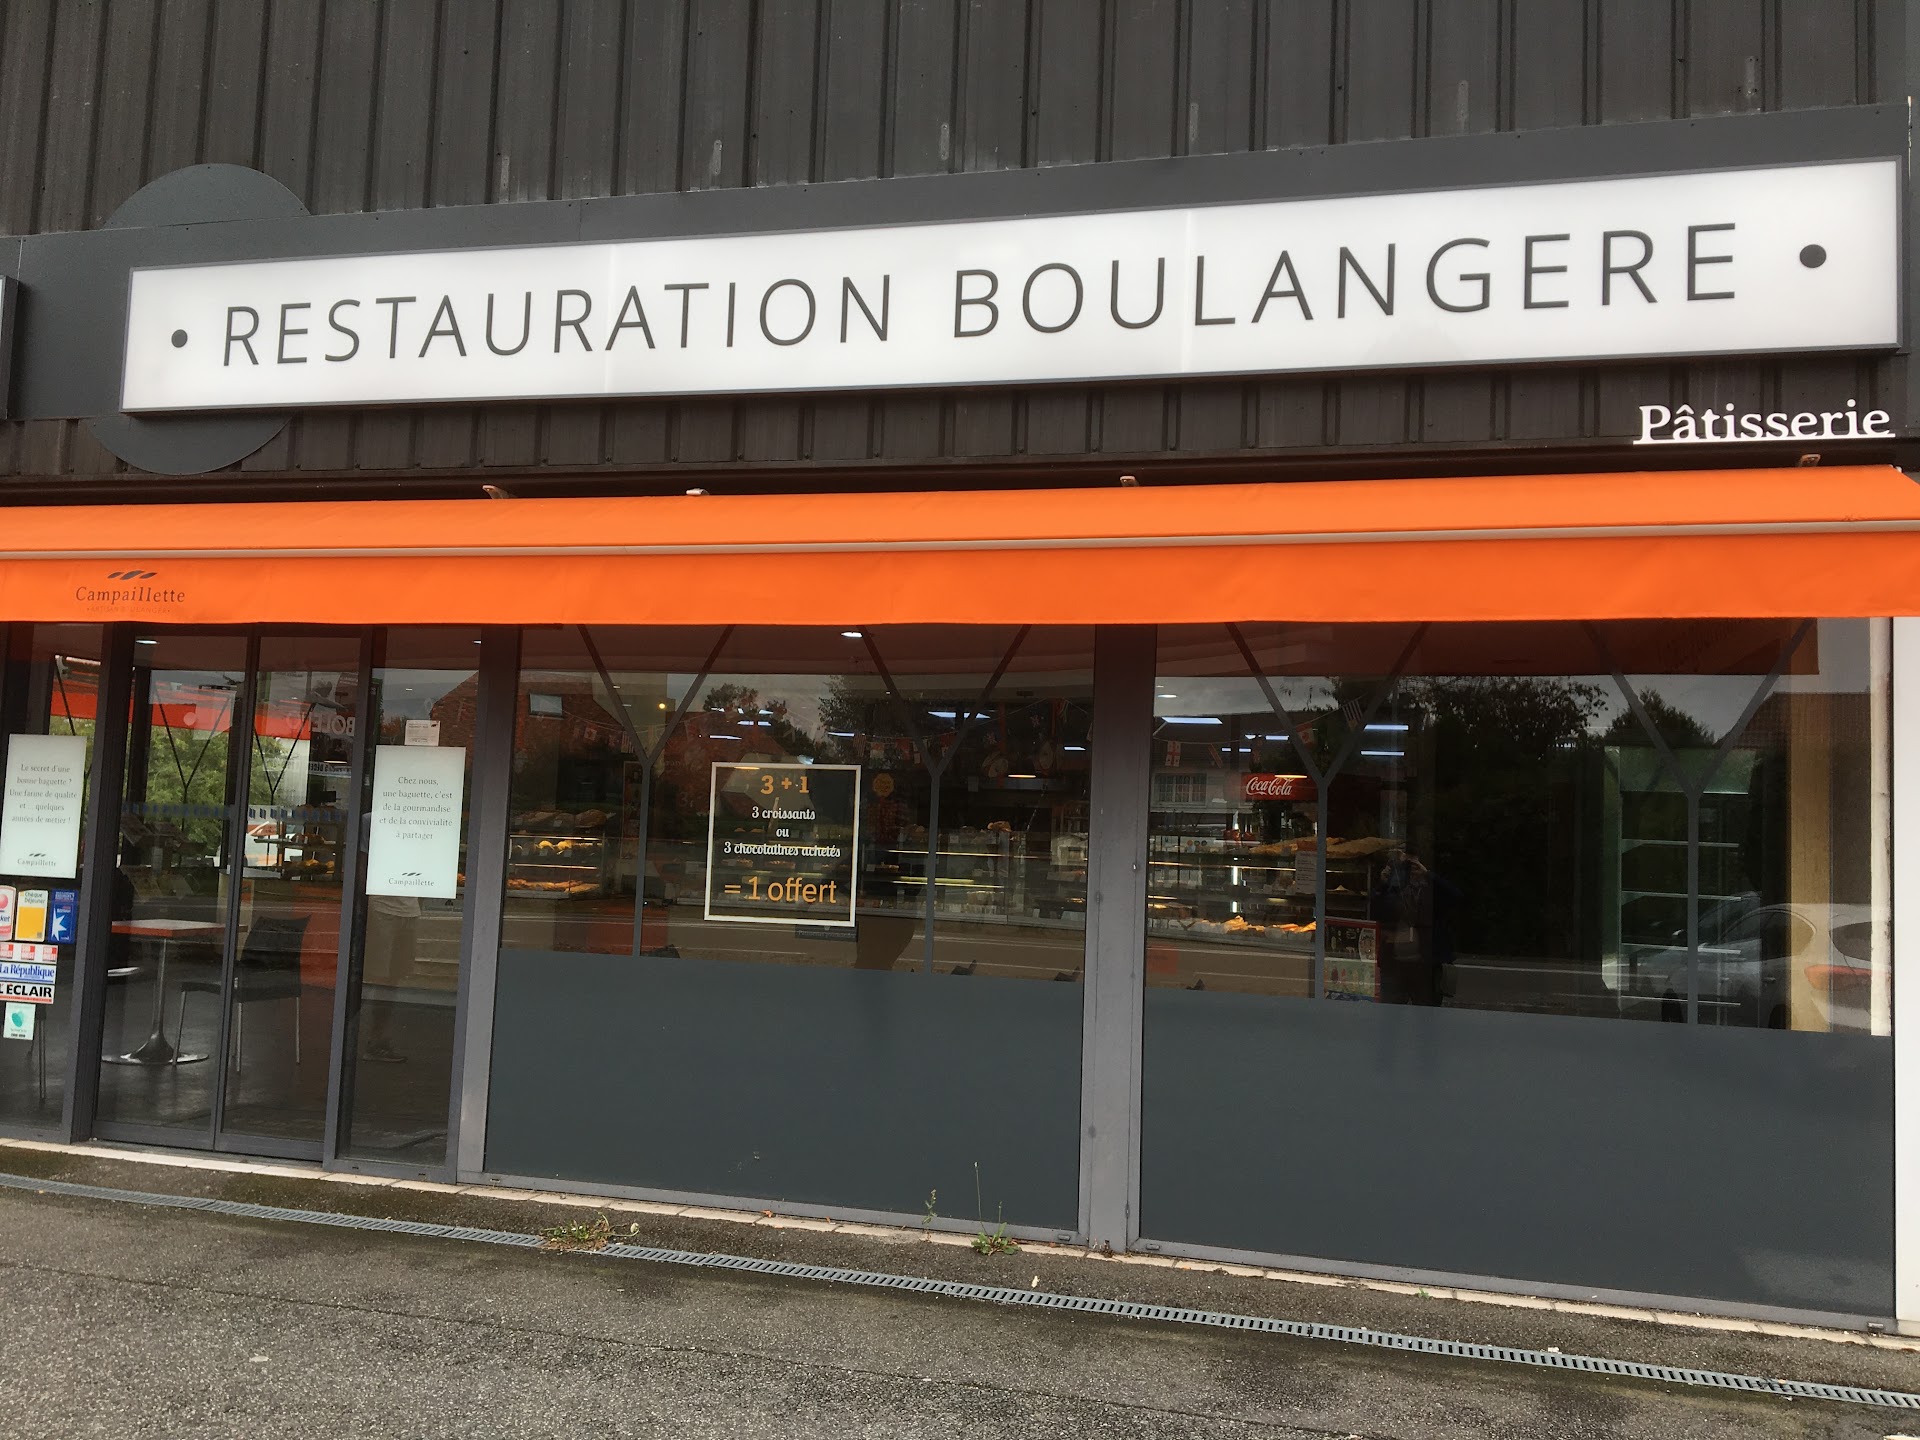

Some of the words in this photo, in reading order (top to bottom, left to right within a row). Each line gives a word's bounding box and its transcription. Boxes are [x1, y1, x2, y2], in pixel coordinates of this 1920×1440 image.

[222, 273, 892, 368] RESTAURATION
[952, 222, 1737, 339] BOULANGERE
[1636, 398, 1894, 443] Pâtisserie
[75, 586, 185, 605] Campaillette
[20, 763, 29, 772] Le
[51, 765, 71, 773] d'une
[16, 776, 37, 784] bonne
[38, 777, 67, 786] baguette
[398, 776, 417, 784] Chez
[760, 774, 774, 795] 3
[781, 777, 793, 790] +
[799, 776, 810, 794] 1
[1246, 775, 1294, 796] Coca-Cola
[9, 788, 23, 796] Une
[24, 788, 44, 797] farine
[54, 791, 77, 800] qualité
[398, 789, 433, 799] baguette,
[434, 790, 453, 799] c'est
[35, 803, 65, 812] quelques
[382, 803, 392, 811] de
[393, 803, 401, 811] la
[402, 804, 451, 813] gourmandise
[751, 806, 760, 819] 3
[761, 807, 816, 820] croissants
[11, 815, 34, 823] années
[35, 815, 43, 823] de
[45, 816, 66, 824] métier
[388, 816, 398, 825] de
[399, 816, 407, 825] la
[408, 818, 453, 827] convivialité
[395, 830, 401, 838] à
[402, 832, 433, 841] partager
[775, 828, 790, 838] ou
[723, 841, 732, 854] 3
[801, 844, 841, 858] achetés
[17, 858, 56, 867] Campaillette
[388, 877, 435, 887] Campaillette
[24, 891, 43, 899] Chèque
[724, 883, 742, 895] =
[748, 876, 761, 900] 1
[767, 877, 837, 904] offert
[10, 964, 55, 979] République
